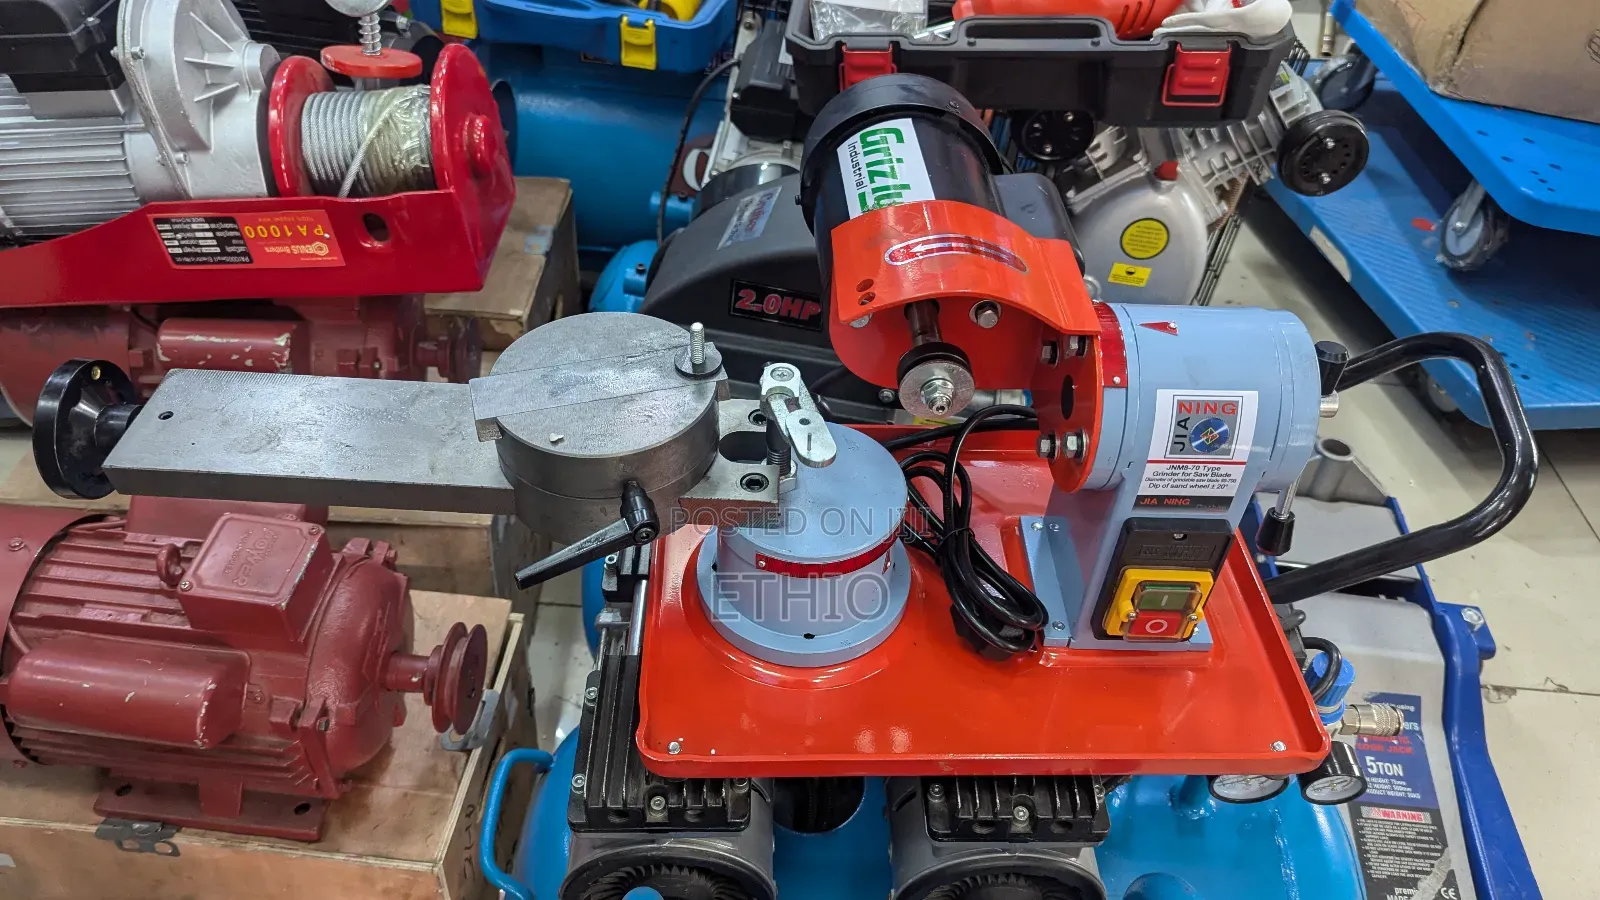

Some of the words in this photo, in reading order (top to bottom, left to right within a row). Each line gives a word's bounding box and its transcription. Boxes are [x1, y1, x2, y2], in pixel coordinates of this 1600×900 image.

[847, 140, 868, 191] Industrial
[243, 224, 324, 239] PA1000
[735, 288, 821, 320] 2.0HP
[1178, 400, 1237, 415] NING
[1173, 416, 1190, 453] JIA
[1387, 745, 1414, 755] JACK
[1365, 755, 1404, 777] 5TON
[1366, 788, 1386, 796] RODUCT
[1381, 810, 1423, 822] WARNING
